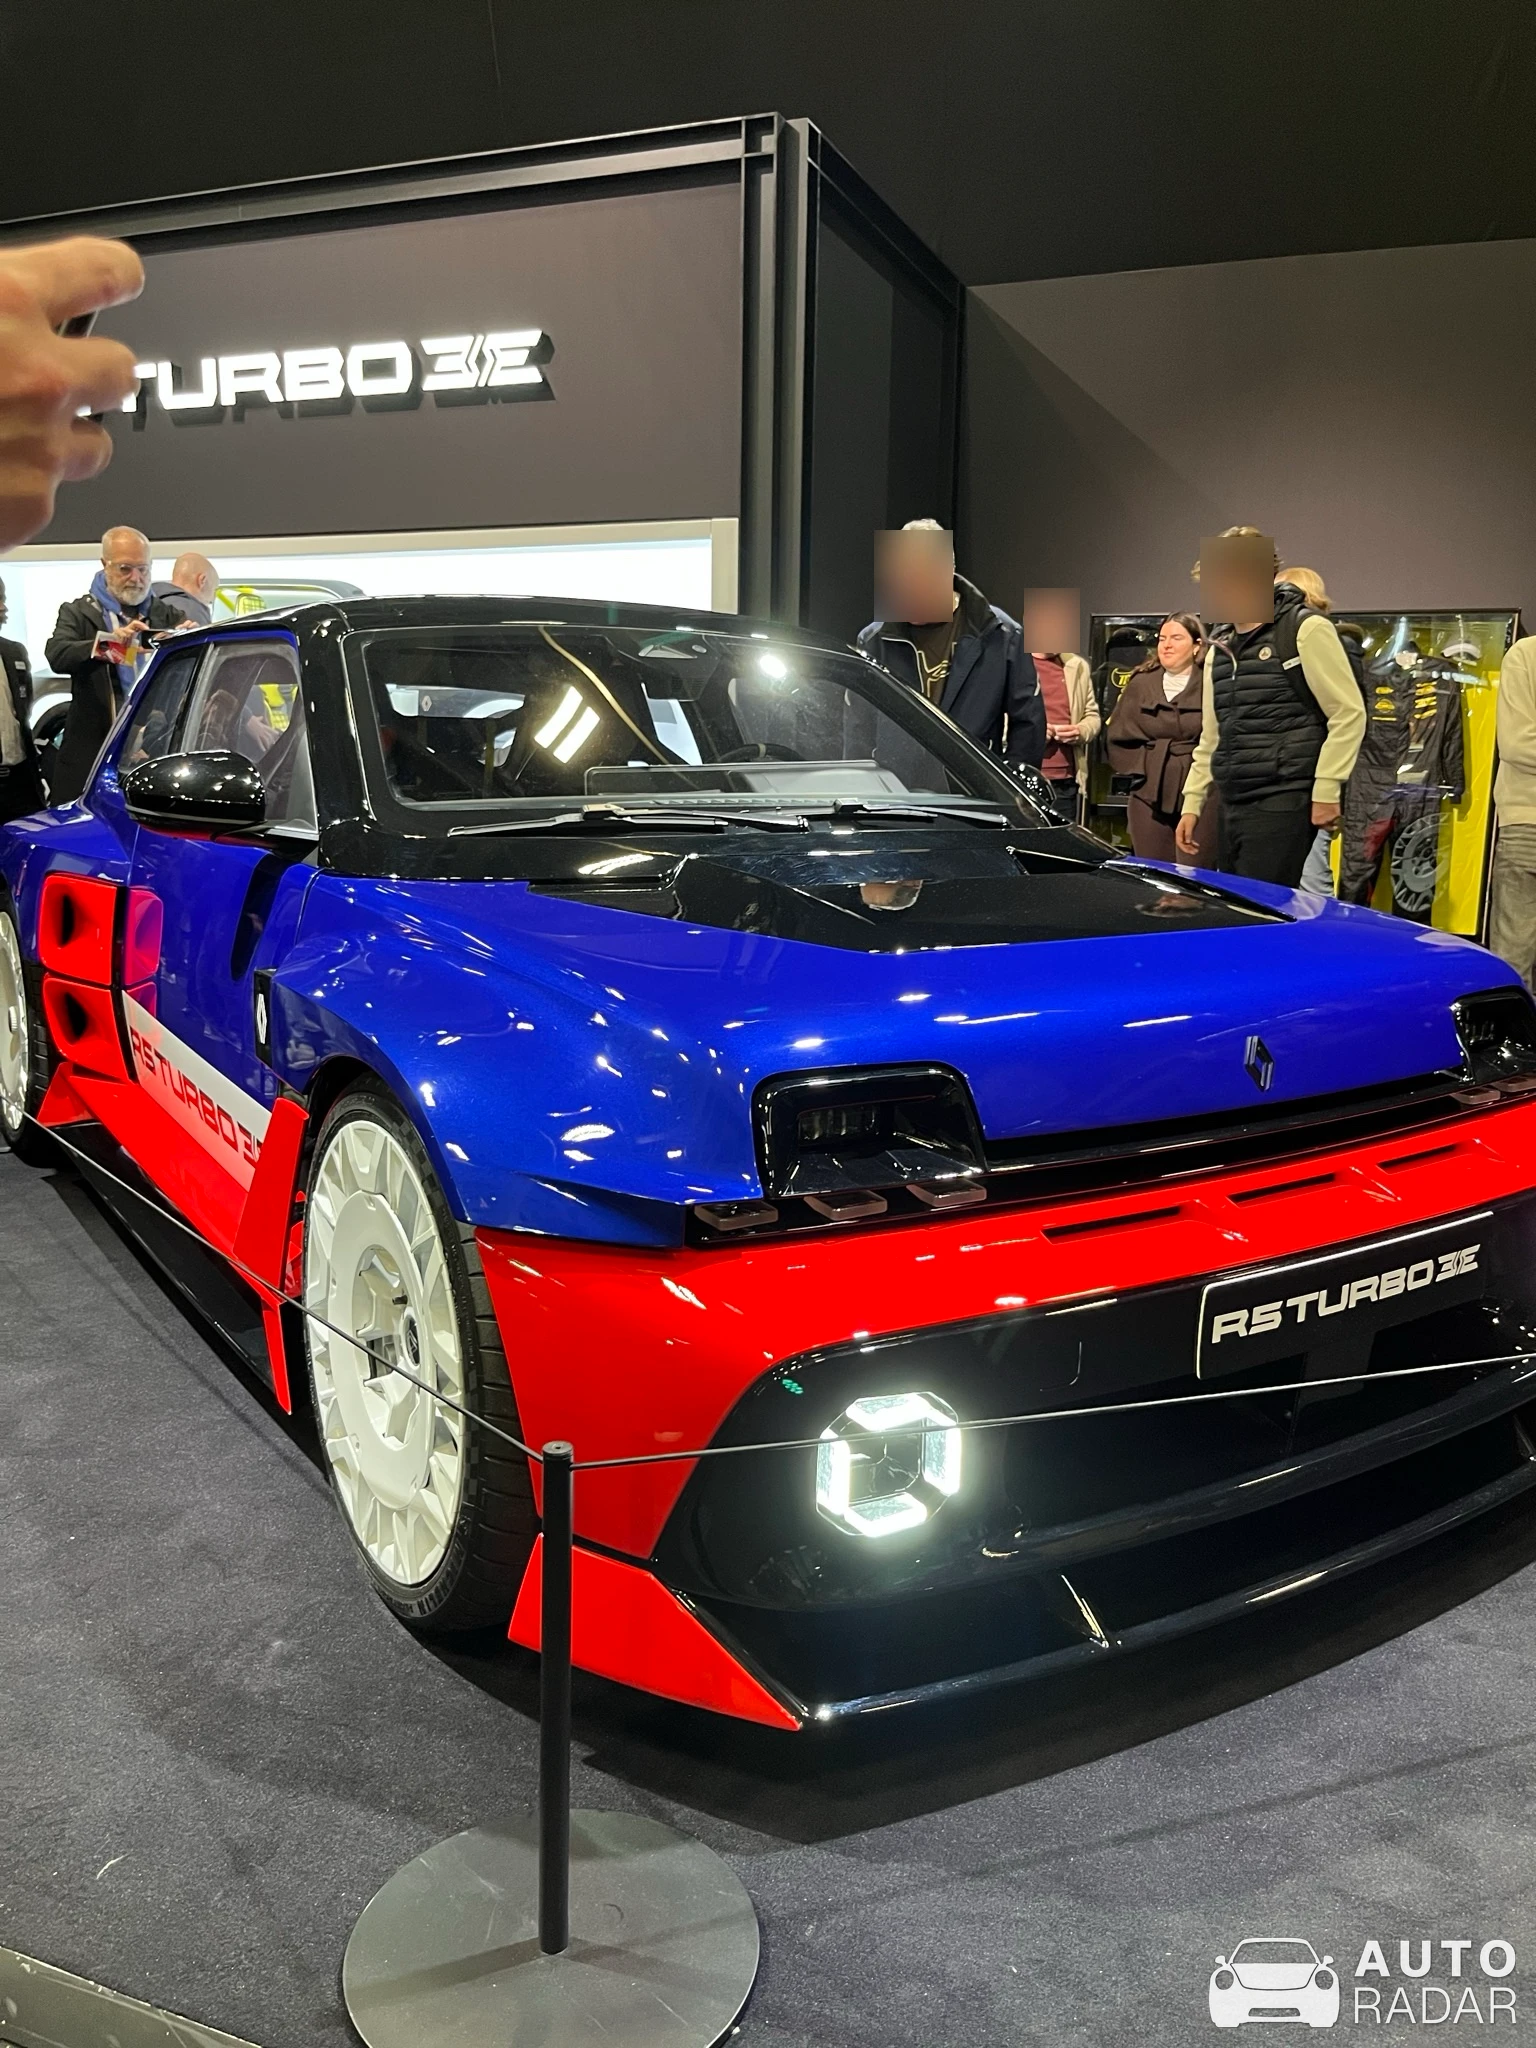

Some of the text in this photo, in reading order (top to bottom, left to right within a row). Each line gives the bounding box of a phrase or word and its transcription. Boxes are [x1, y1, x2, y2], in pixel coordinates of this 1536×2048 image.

[154, 1048, 239, 1153] TURBO
[236, 1121, 263, 1169] 3
[1211, 1301, 1283, 1344] R5
[1286, 1260, 1434, 1323] TURBO
